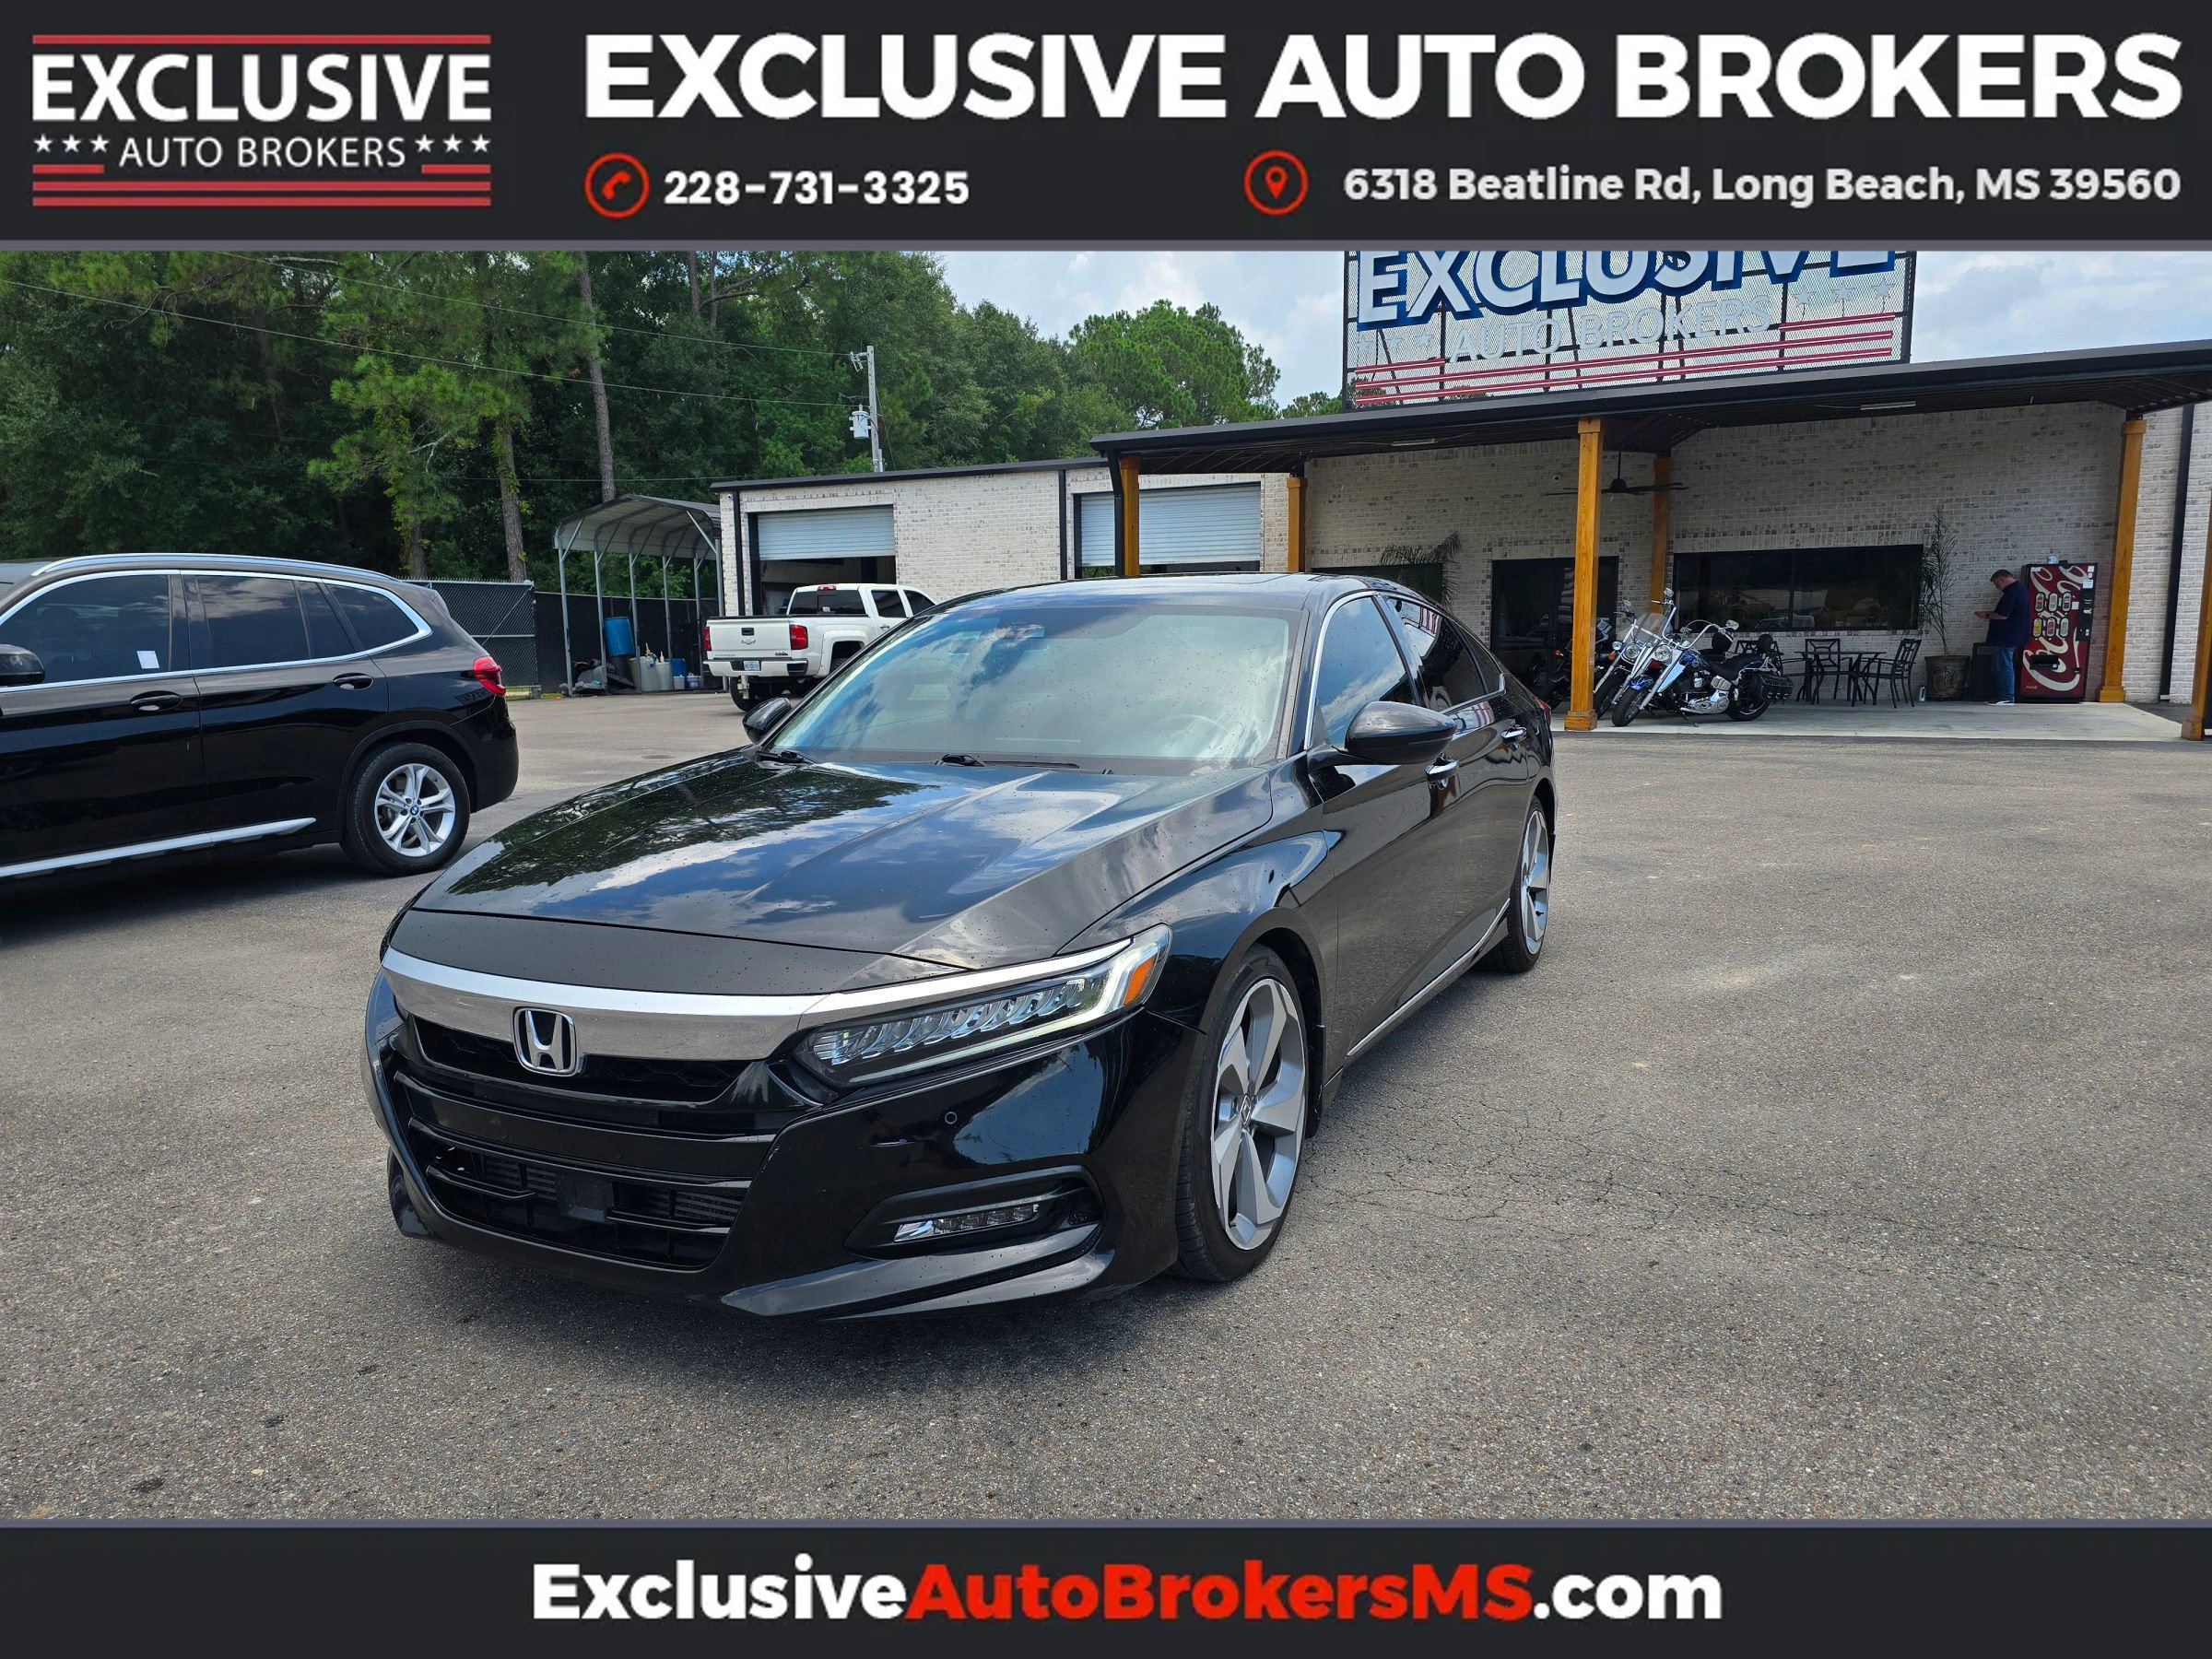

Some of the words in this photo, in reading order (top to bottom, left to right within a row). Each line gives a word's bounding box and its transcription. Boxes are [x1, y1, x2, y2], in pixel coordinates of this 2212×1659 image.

[1358, 251, 1891, 326] EXCLUS
[1450, 318, 1561, 363] AUTO
[1580, 294, 1772, 350] BROKERS
